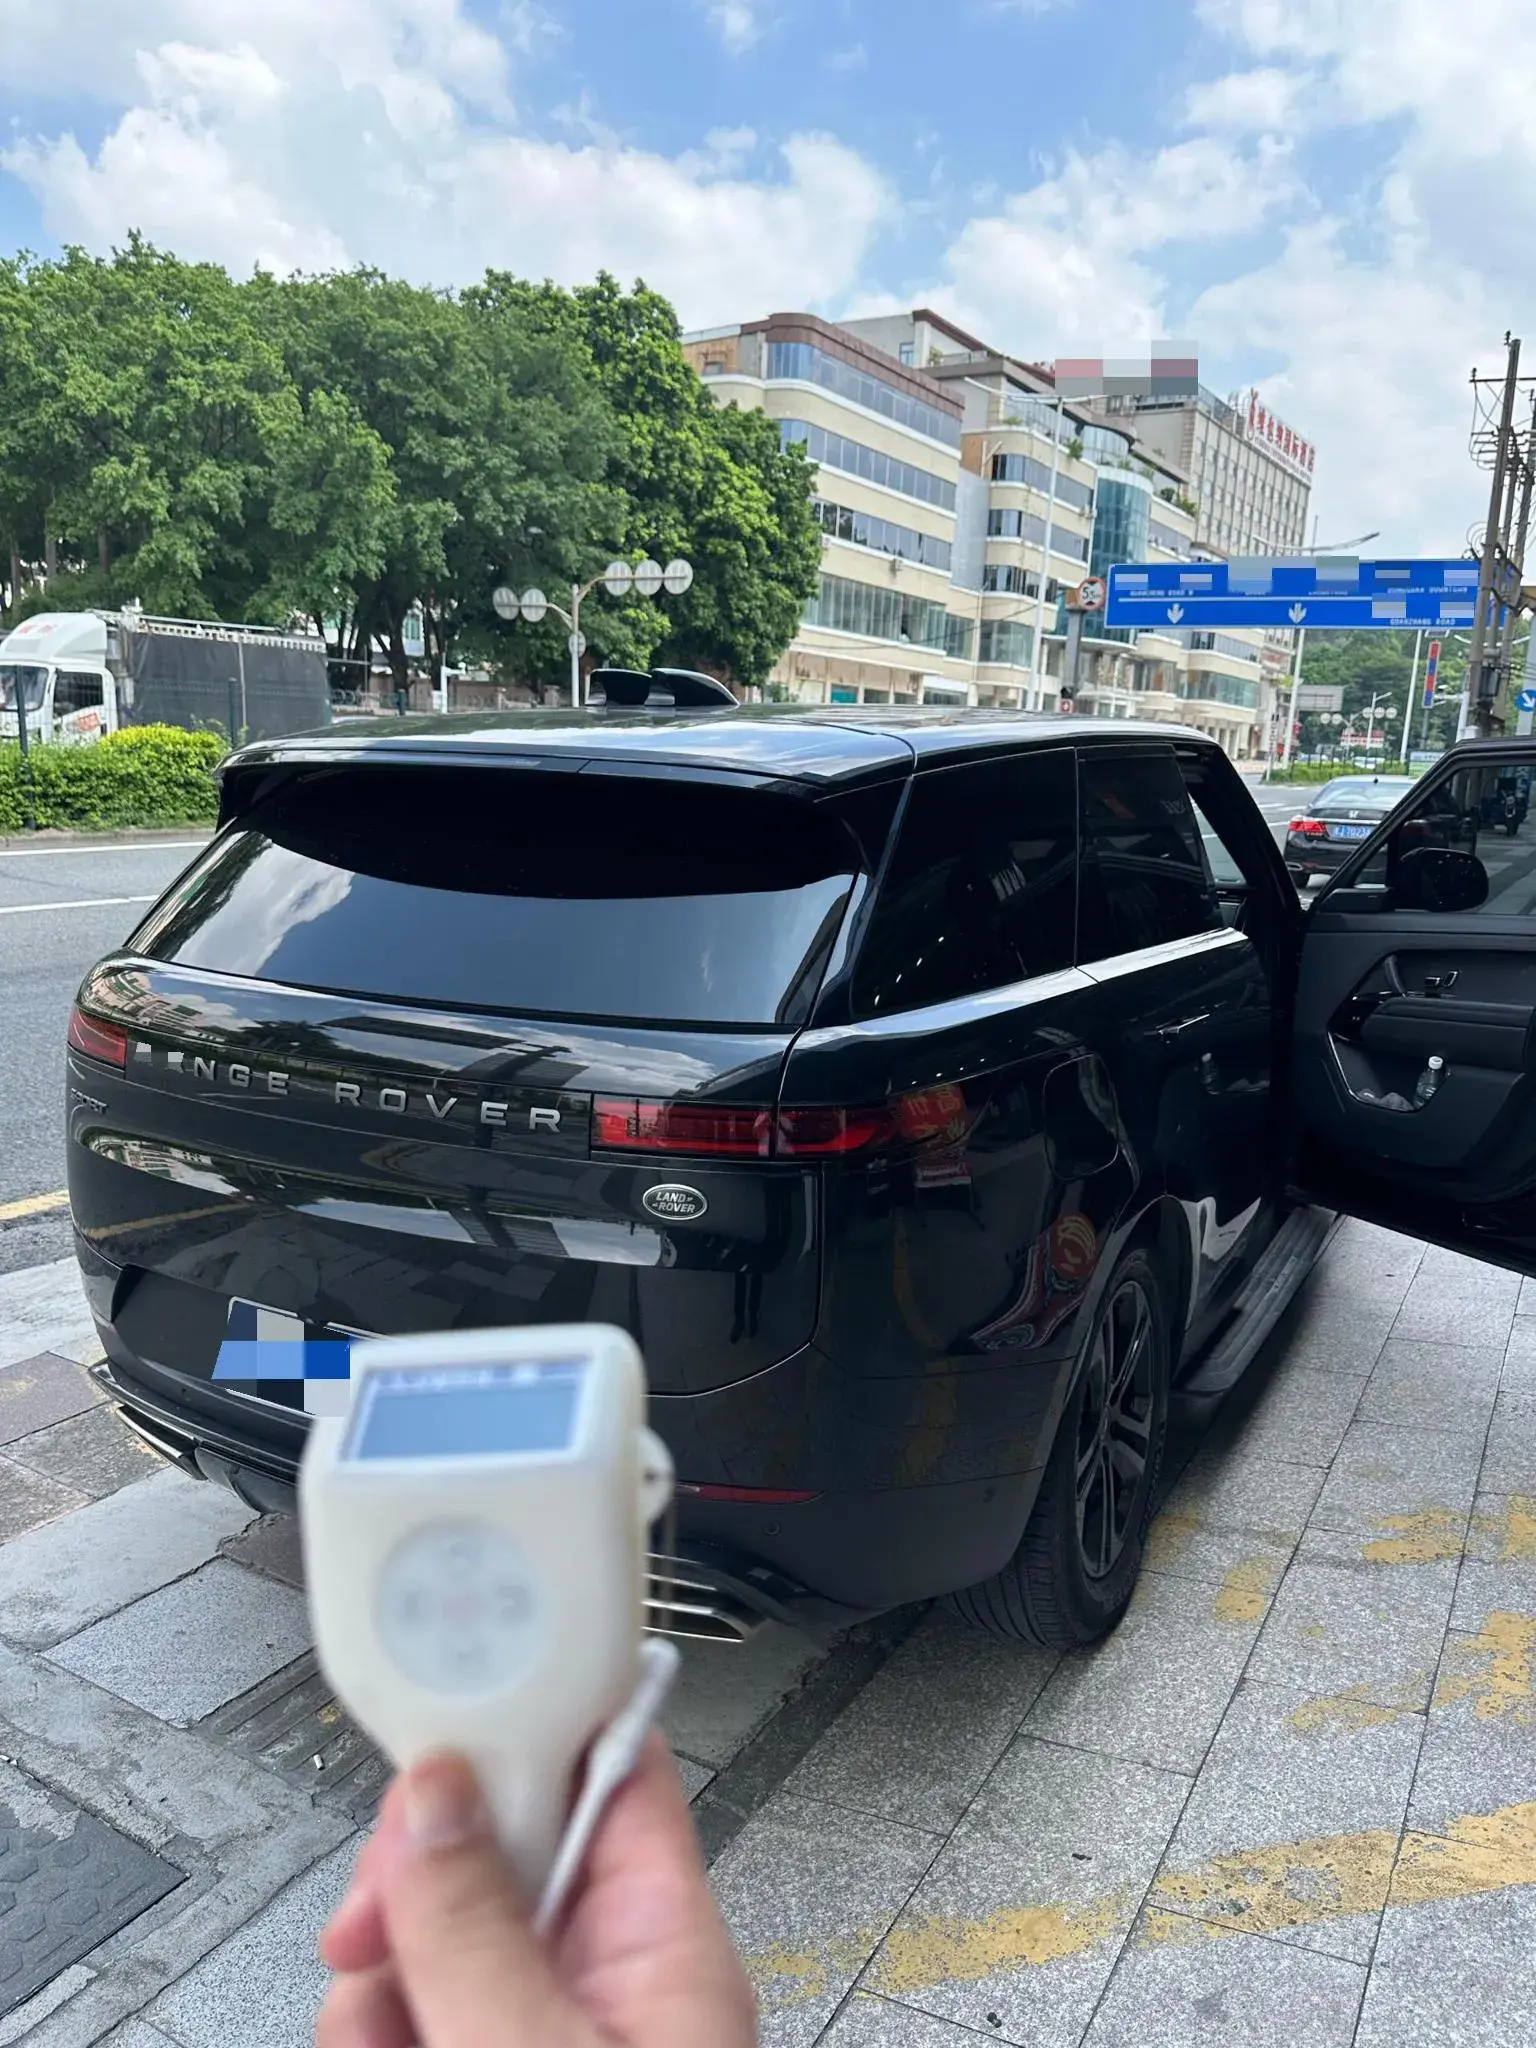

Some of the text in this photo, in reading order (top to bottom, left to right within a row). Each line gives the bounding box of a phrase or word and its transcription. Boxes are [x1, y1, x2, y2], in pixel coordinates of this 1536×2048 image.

[335, 1082, 561, 1133] ROVER
[656, 1192, 686, 1203] LAND
[658, 1202, 695, 1213] ROVER
